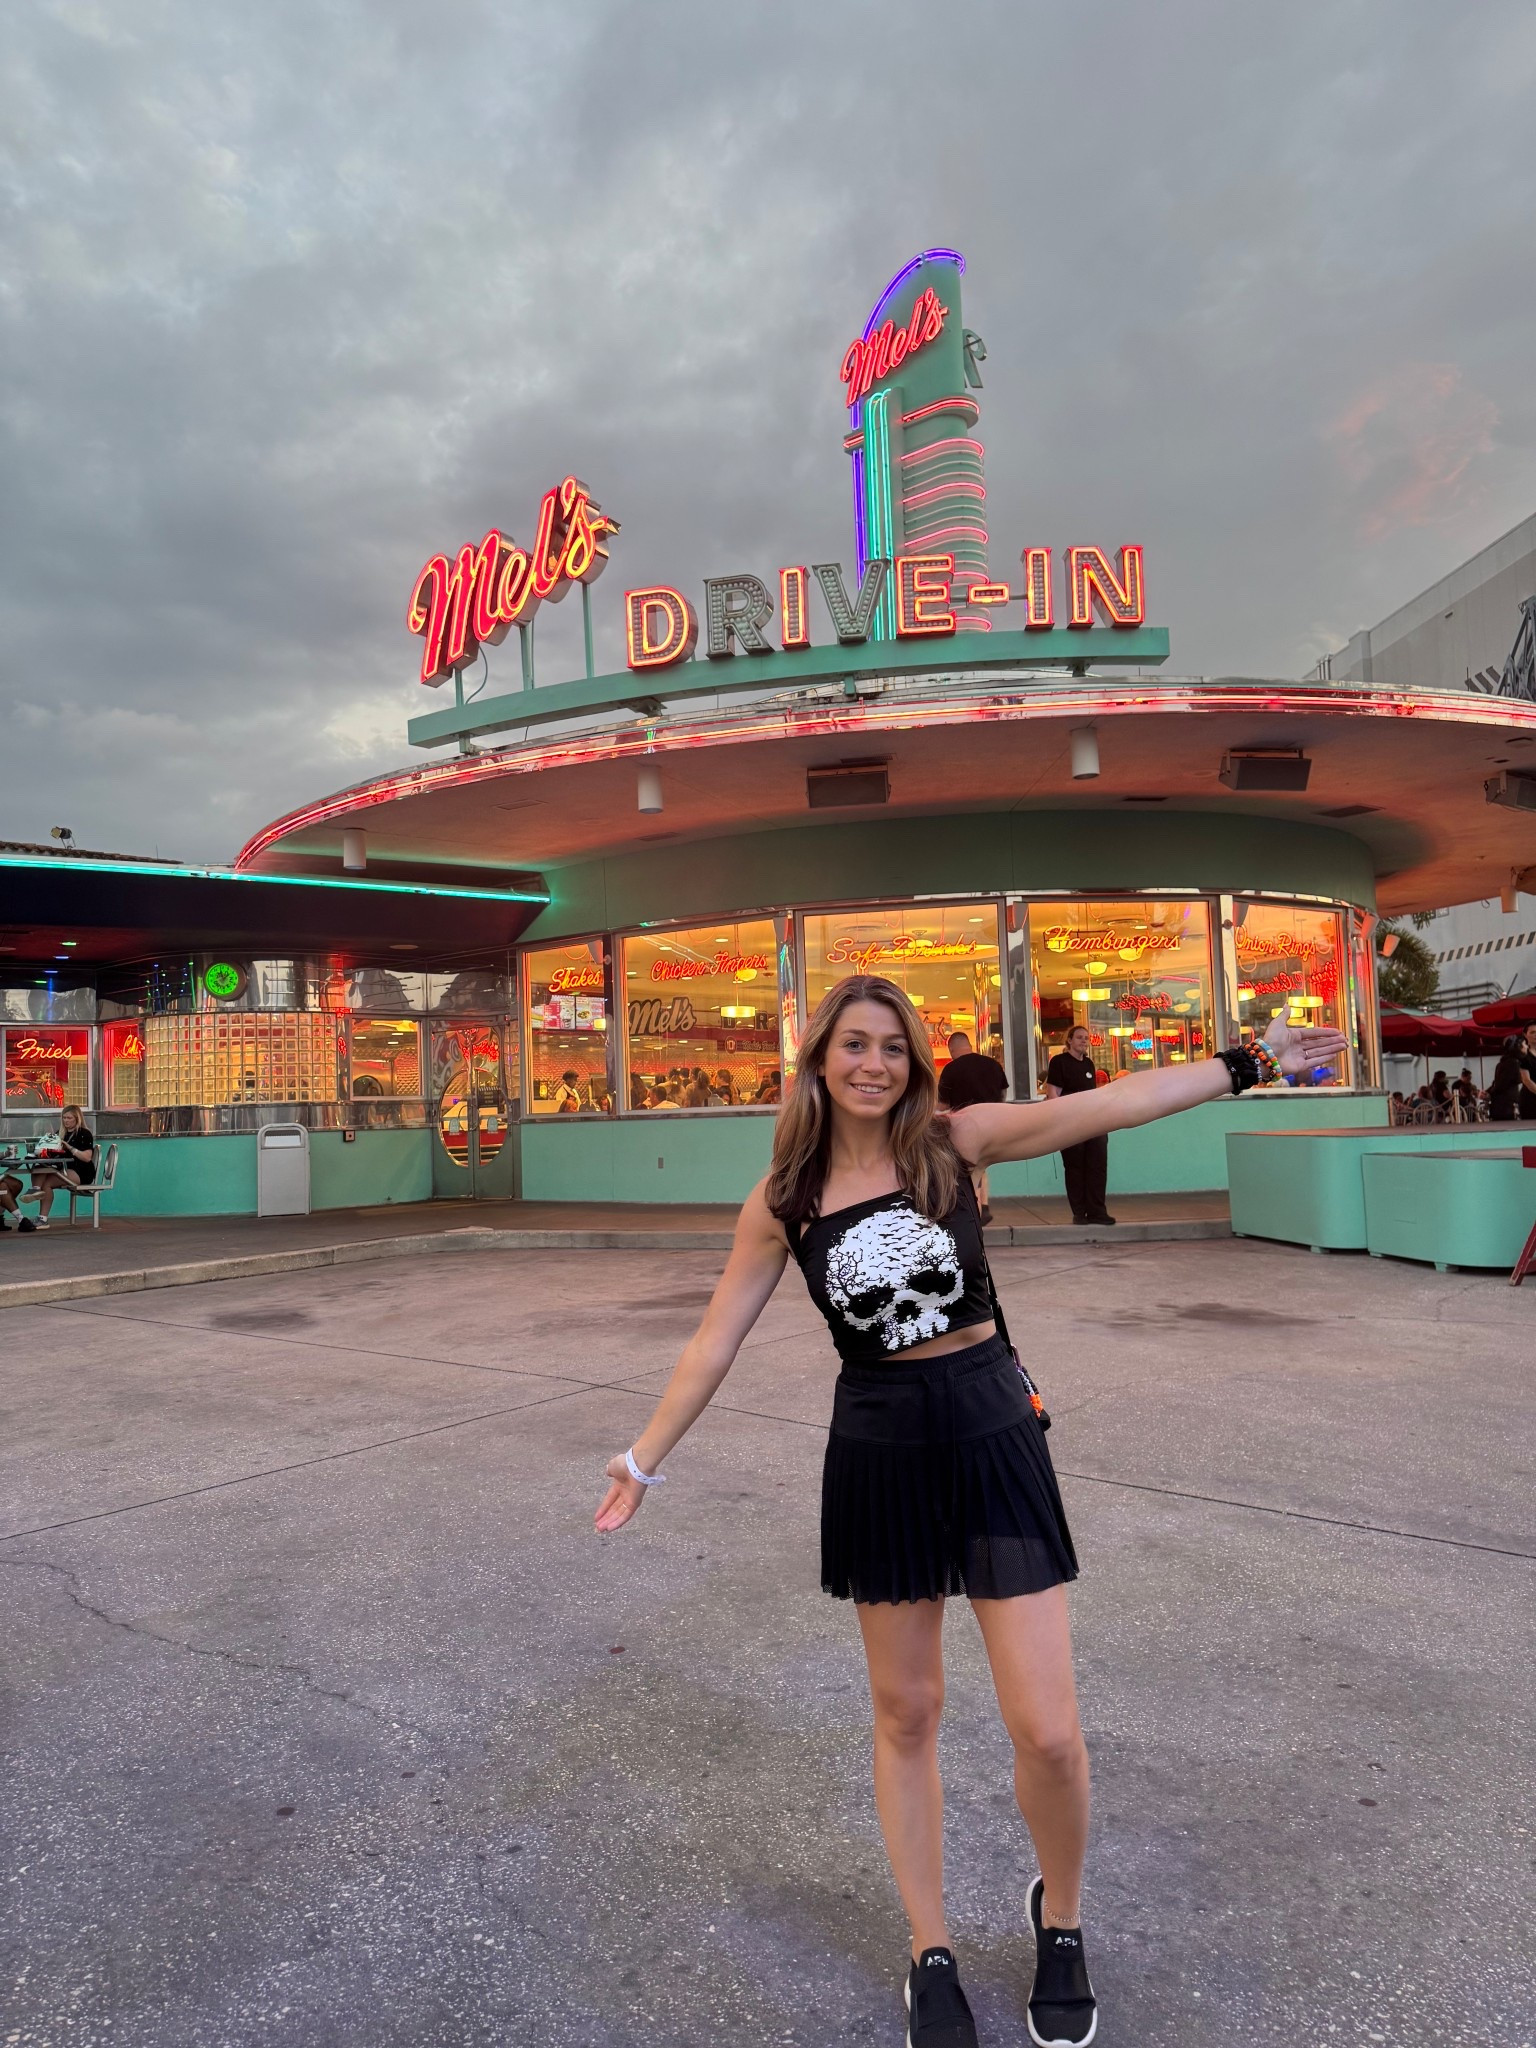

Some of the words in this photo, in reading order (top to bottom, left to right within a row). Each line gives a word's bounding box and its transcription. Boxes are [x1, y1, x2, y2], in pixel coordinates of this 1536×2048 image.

[840, 287, 949, 407] Mel's
[407, 475, 618, 688] Mel's
[624, 545, 1144, 671] DRIVE-IN
[826, 937, 886, 970] Soft
[892, 933, 977, 961] Drinks
[1044, 925, 1180, 956] Hamburgers
[1234, 924, 1274, 954] Onion
[1277, 932, 1316, 962] Rings
[548, 967, 602, 993] Shakes
[651, 959, 706, 982] Chicken
[710, 951, 769, 981] Fingers
[628, 997, 697, 1036] Mel's
[16, 1038, 73, 1060] Fries
